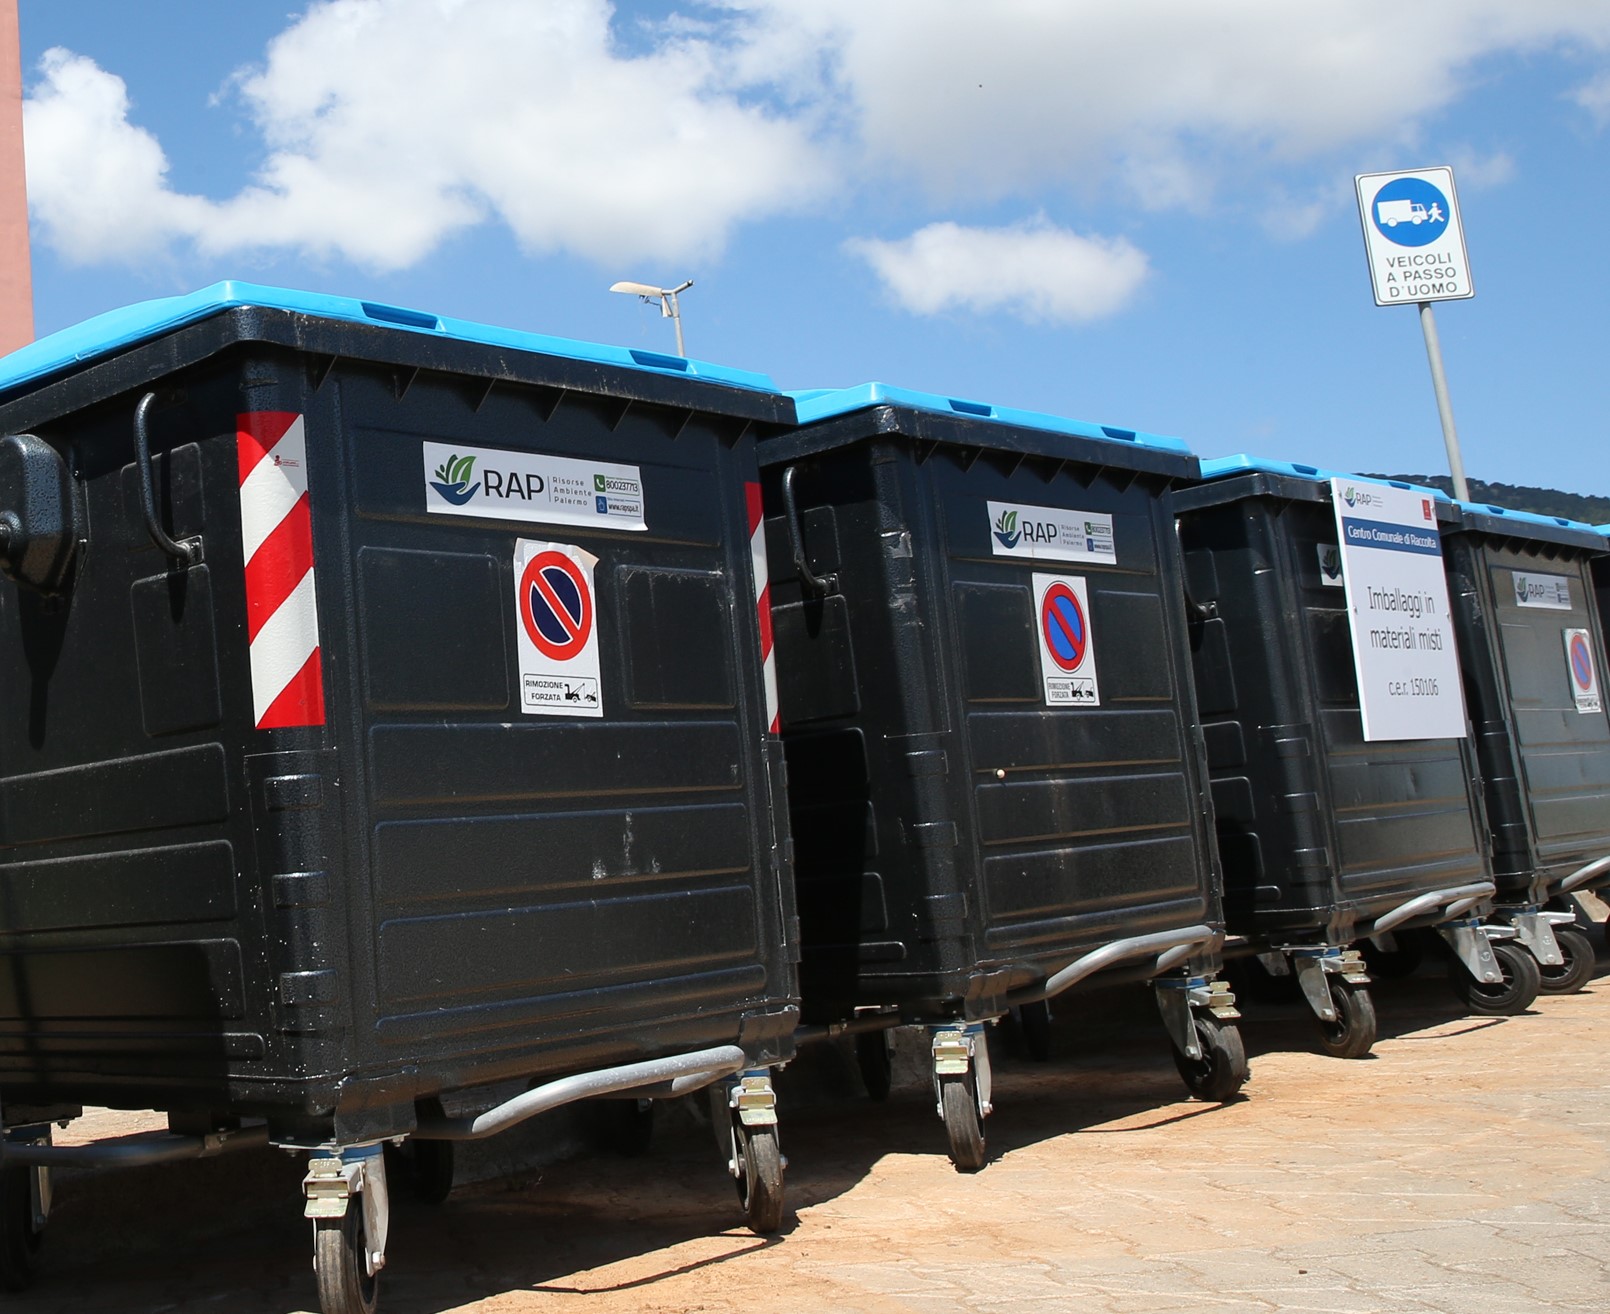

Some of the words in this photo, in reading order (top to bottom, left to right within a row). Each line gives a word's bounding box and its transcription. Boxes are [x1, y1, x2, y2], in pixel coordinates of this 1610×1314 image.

[1386, 252, 1452, 268] VEICOLI
[1387, 272, 1397, 283] A
[1403, 267, 1457, 282] PASSO
[1389, 281, 1458, 298] D'UOMO
[483, 469, 545, 501] RAP
[553, 476, 585, 486] Risorse
[553, 486, 592, 497] Ambiente
[1356, 492, 1372, 506] RAP
[554, 496, 588, 506] Palermo
[1022, 520, 1057, 543] RAP
[1347, 525, 1372, 540] Centro
[1372, 528, 1403, 544] Comunale
[1404, 533, 1410, 545] di
[1411, 534, 1437, 548] Raccolta
[1528, 583, 1545, 598] RAP
[1367, 586, 1423, 619] Imballaggi
[1425, 590, 1435, 614] in
[1370, 626, 1417, 650] materiali
[1418, 630, 1442, 651] misti
[525, 679, 563, 689] RIMOZIONE
[1388, 679, 1408, 696] c.e.r.
[1410, 678, 1439, 696] 150106
[531, 692, 561, 701] FORZATA
